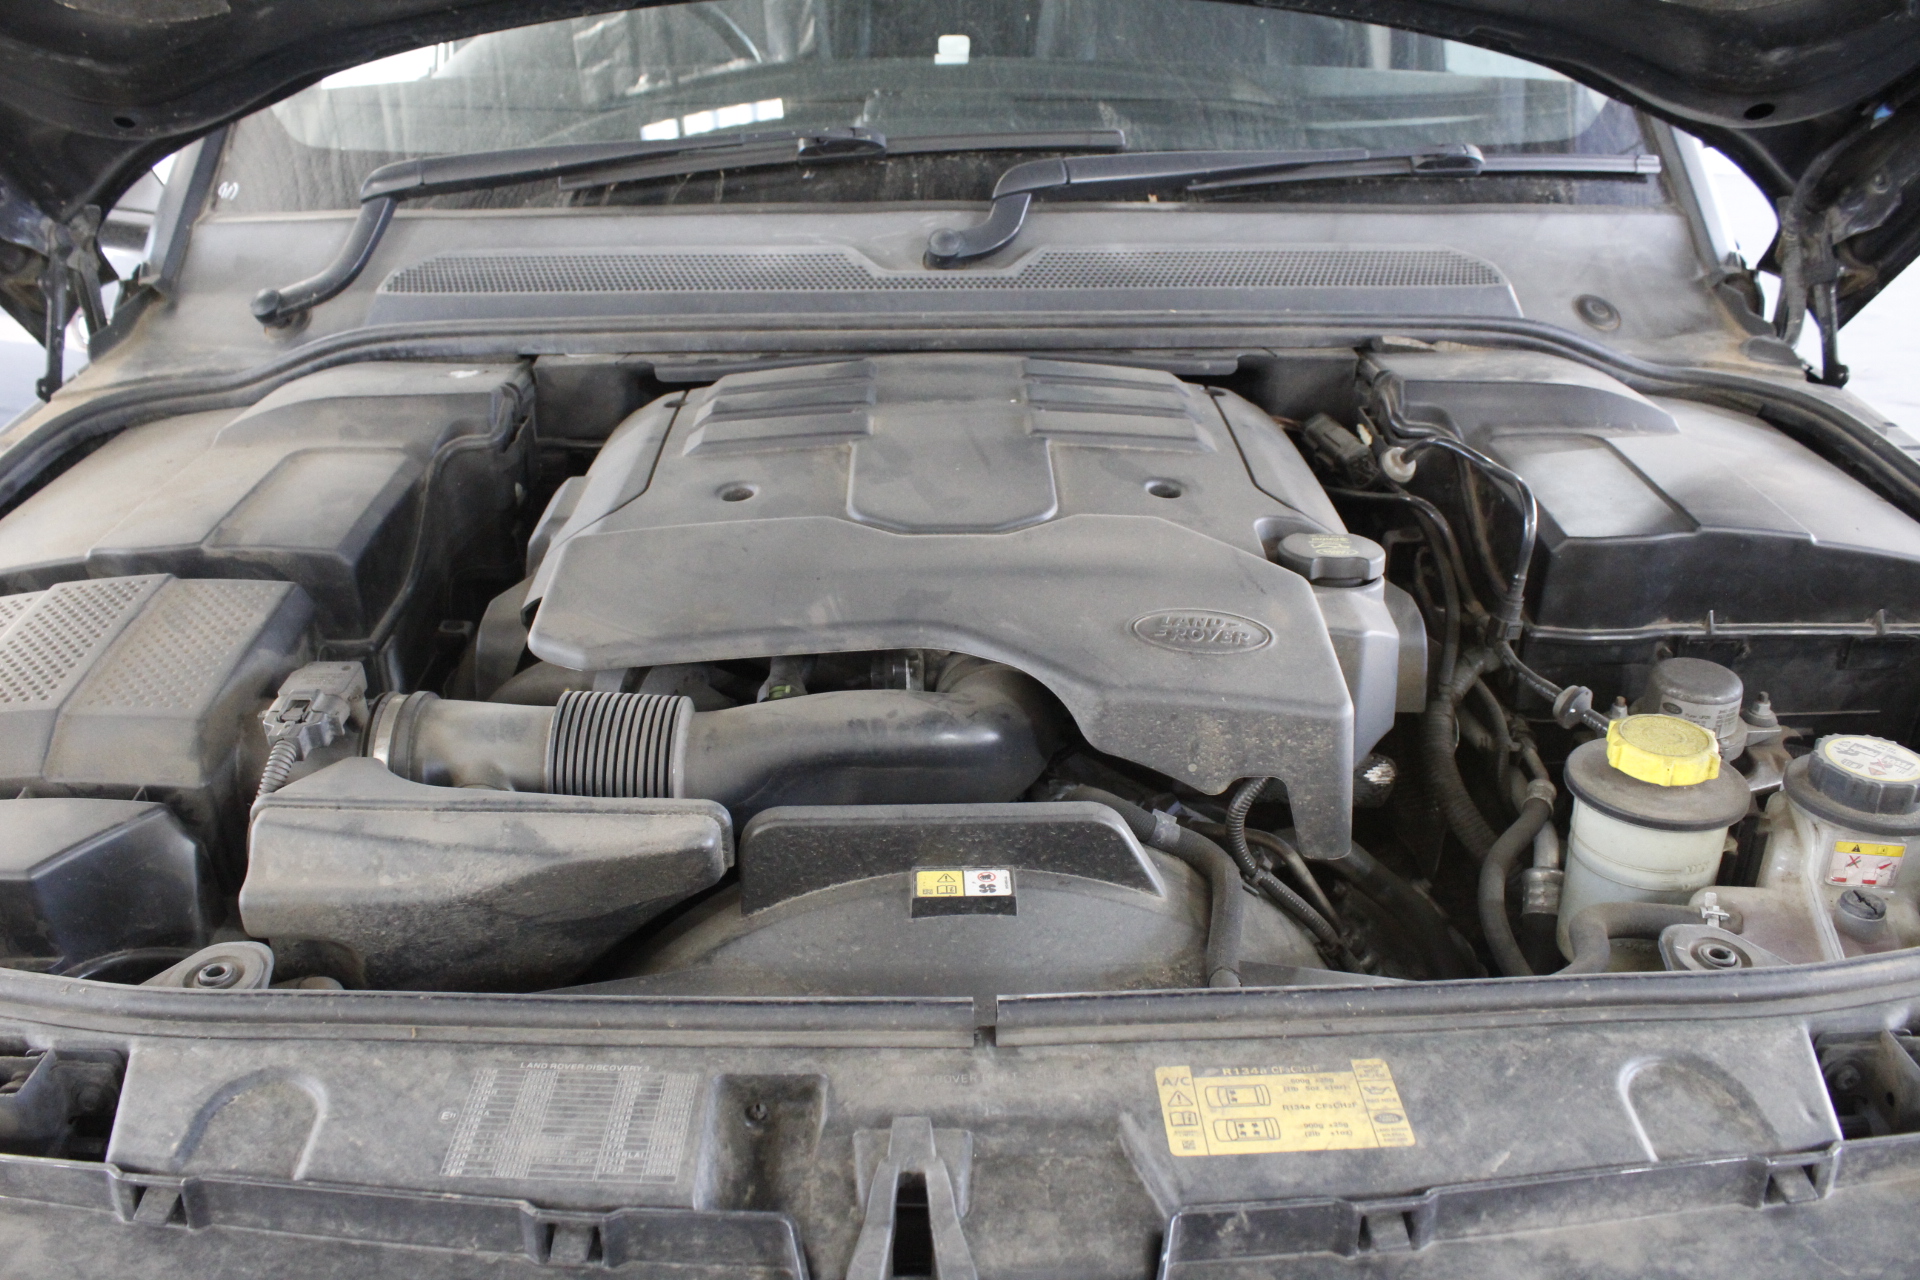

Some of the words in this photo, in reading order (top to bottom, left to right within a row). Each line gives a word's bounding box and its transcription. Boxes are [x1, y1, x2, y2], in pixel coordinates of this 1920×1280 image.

[1161, 616, 1226, 628] LAND
[1169, 628, 1251, 645] ROVER
[520, 1062, 548, 1070] LAND
[550, 1062, 586, 1070] ROVER
[586, 1064, 642, 1072] DISCOVERY
[1222, 1067, 1268, 1076] R134a
[1162, 1076, 1190, 1087] A/C
